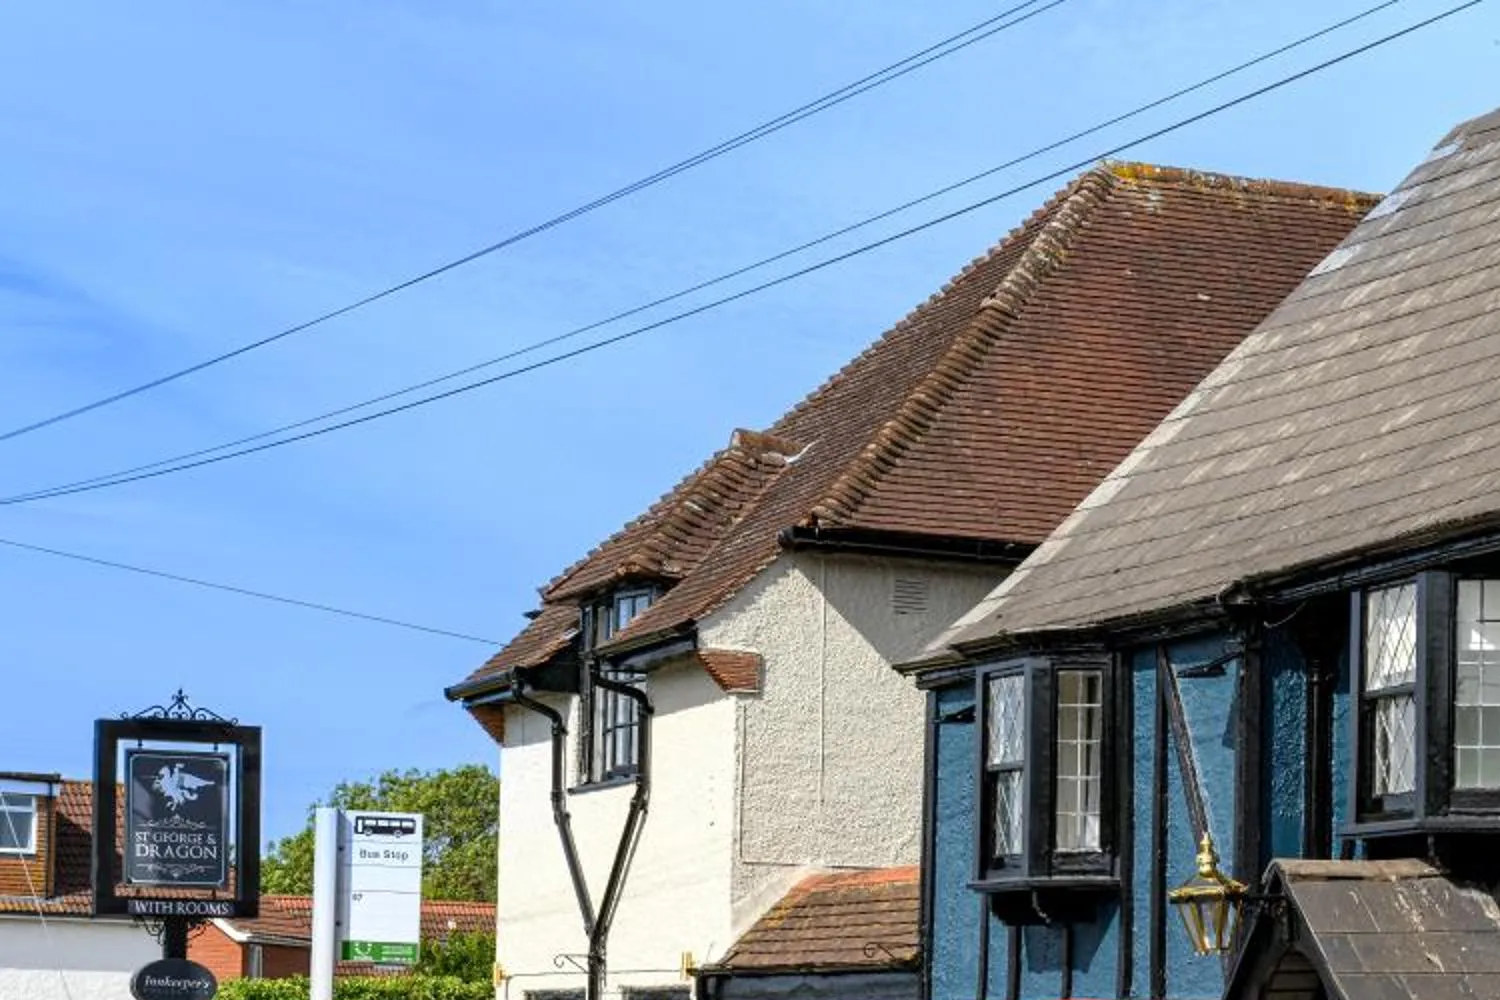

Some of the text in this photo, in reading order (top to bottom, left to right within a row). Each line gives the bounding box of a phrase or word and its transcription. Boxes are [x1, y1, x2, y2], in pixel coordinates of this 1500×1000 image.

[135, 831, 217, 845] ST GEORGE &
[135, 843, 217, 860] DRAGON
[359, 848, 409, 860] Bus Stop
[134, 900, 229, 915] WITH ROOMS
